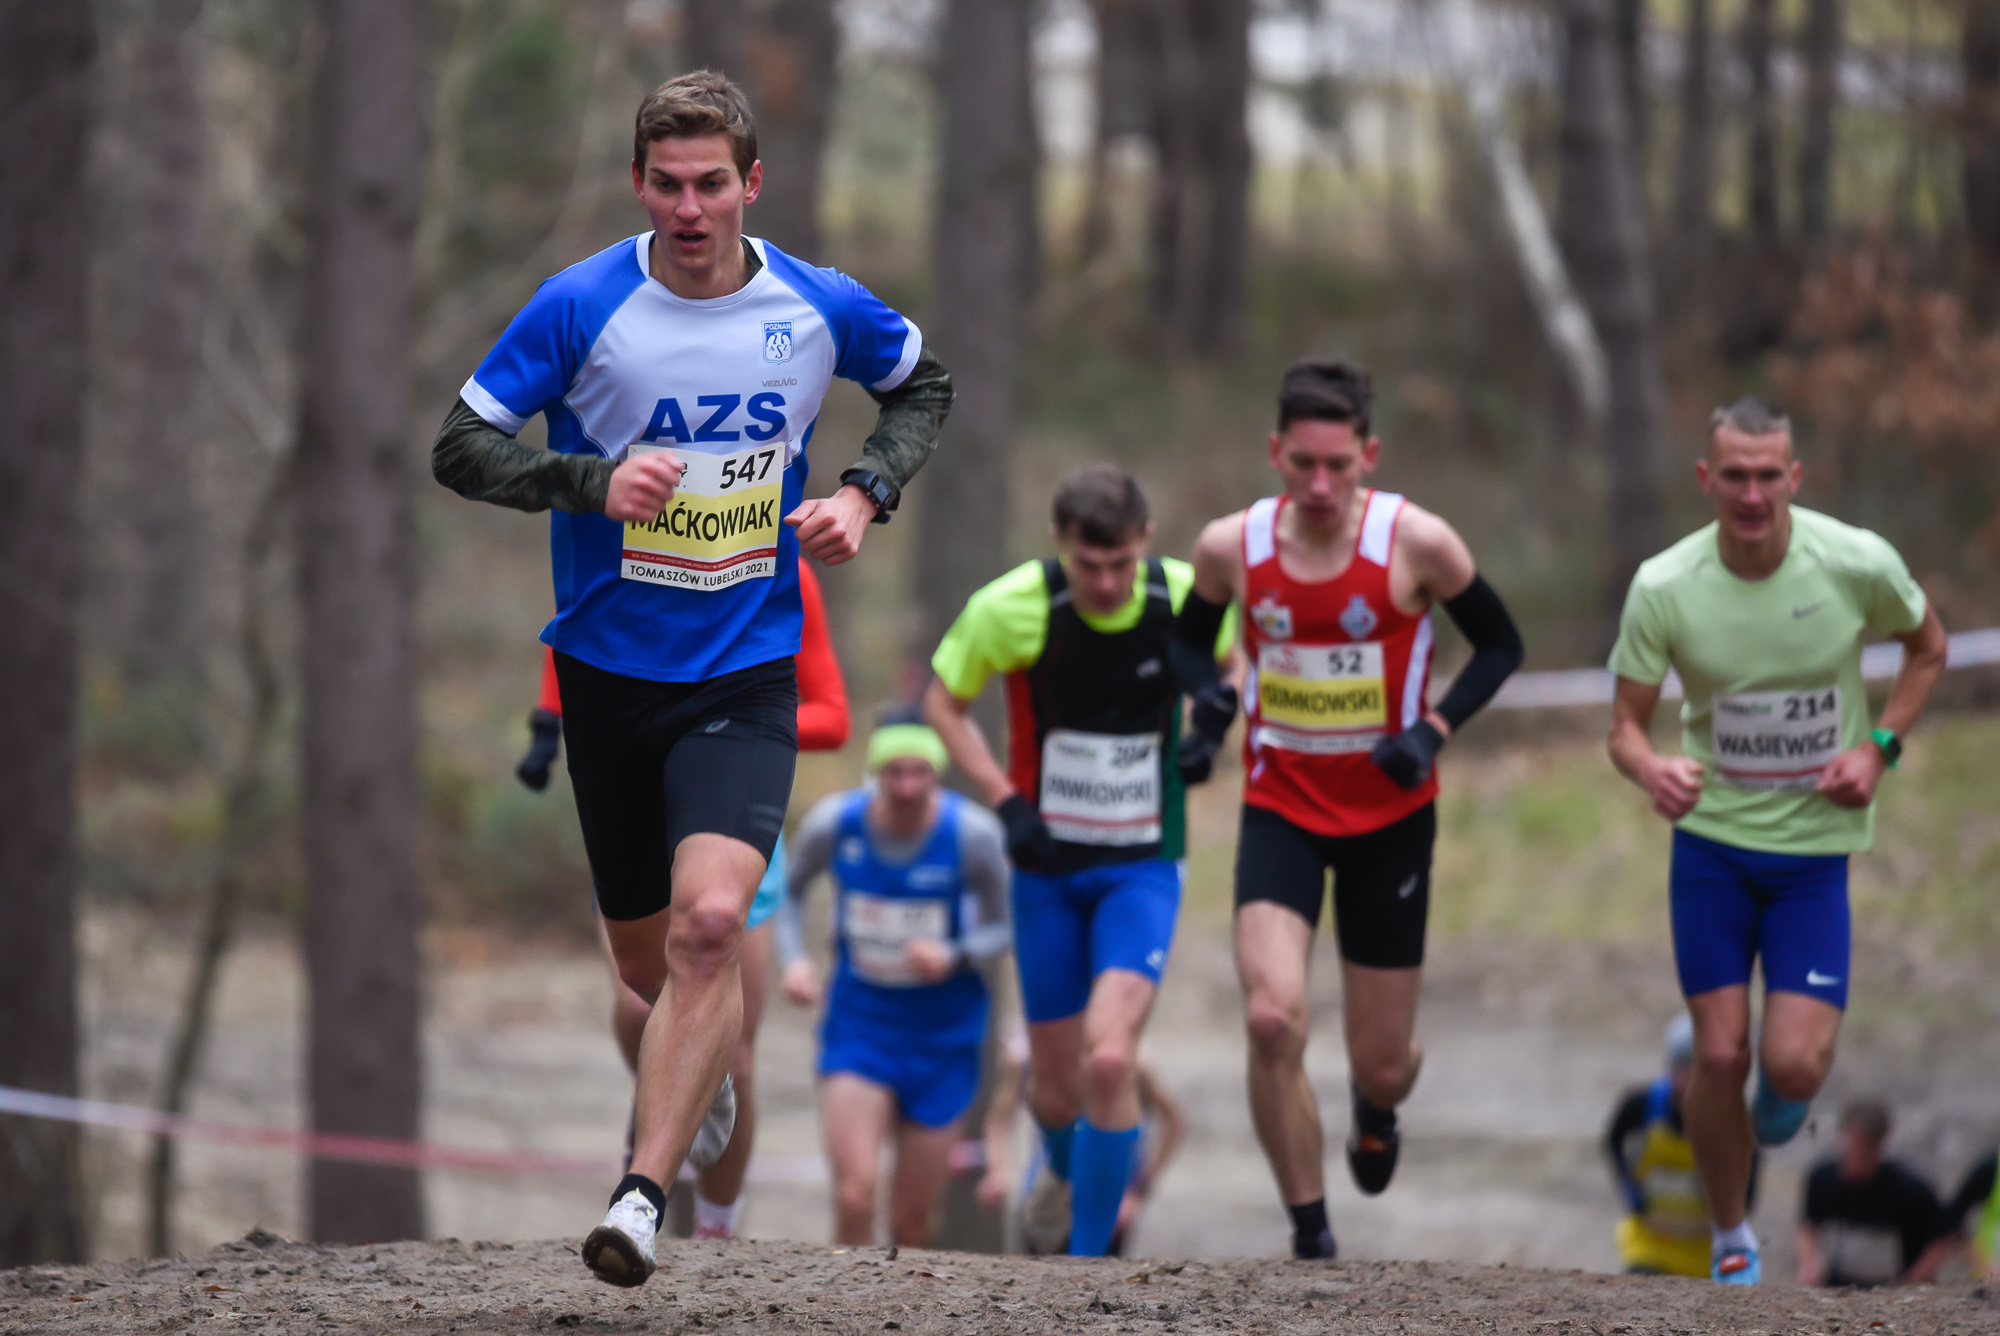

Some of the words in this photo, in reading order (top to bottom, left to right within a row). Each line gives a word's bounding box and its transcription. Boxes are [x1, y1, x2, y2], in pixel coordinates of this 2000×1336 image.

[640, 392, 786, 443] AZS
[719, 450, 776, 489] 547
[630, 565, 700, 585] TOMASZÓW
[704, 568, 742, 586] LUBELSKI
[745, 562, 768, 575] 2021
[1328, 651, 1363, 675] 52
[1785, 689, 1835, 721] 214
[1717, 724, 1837, 758] WASIEWICZ
